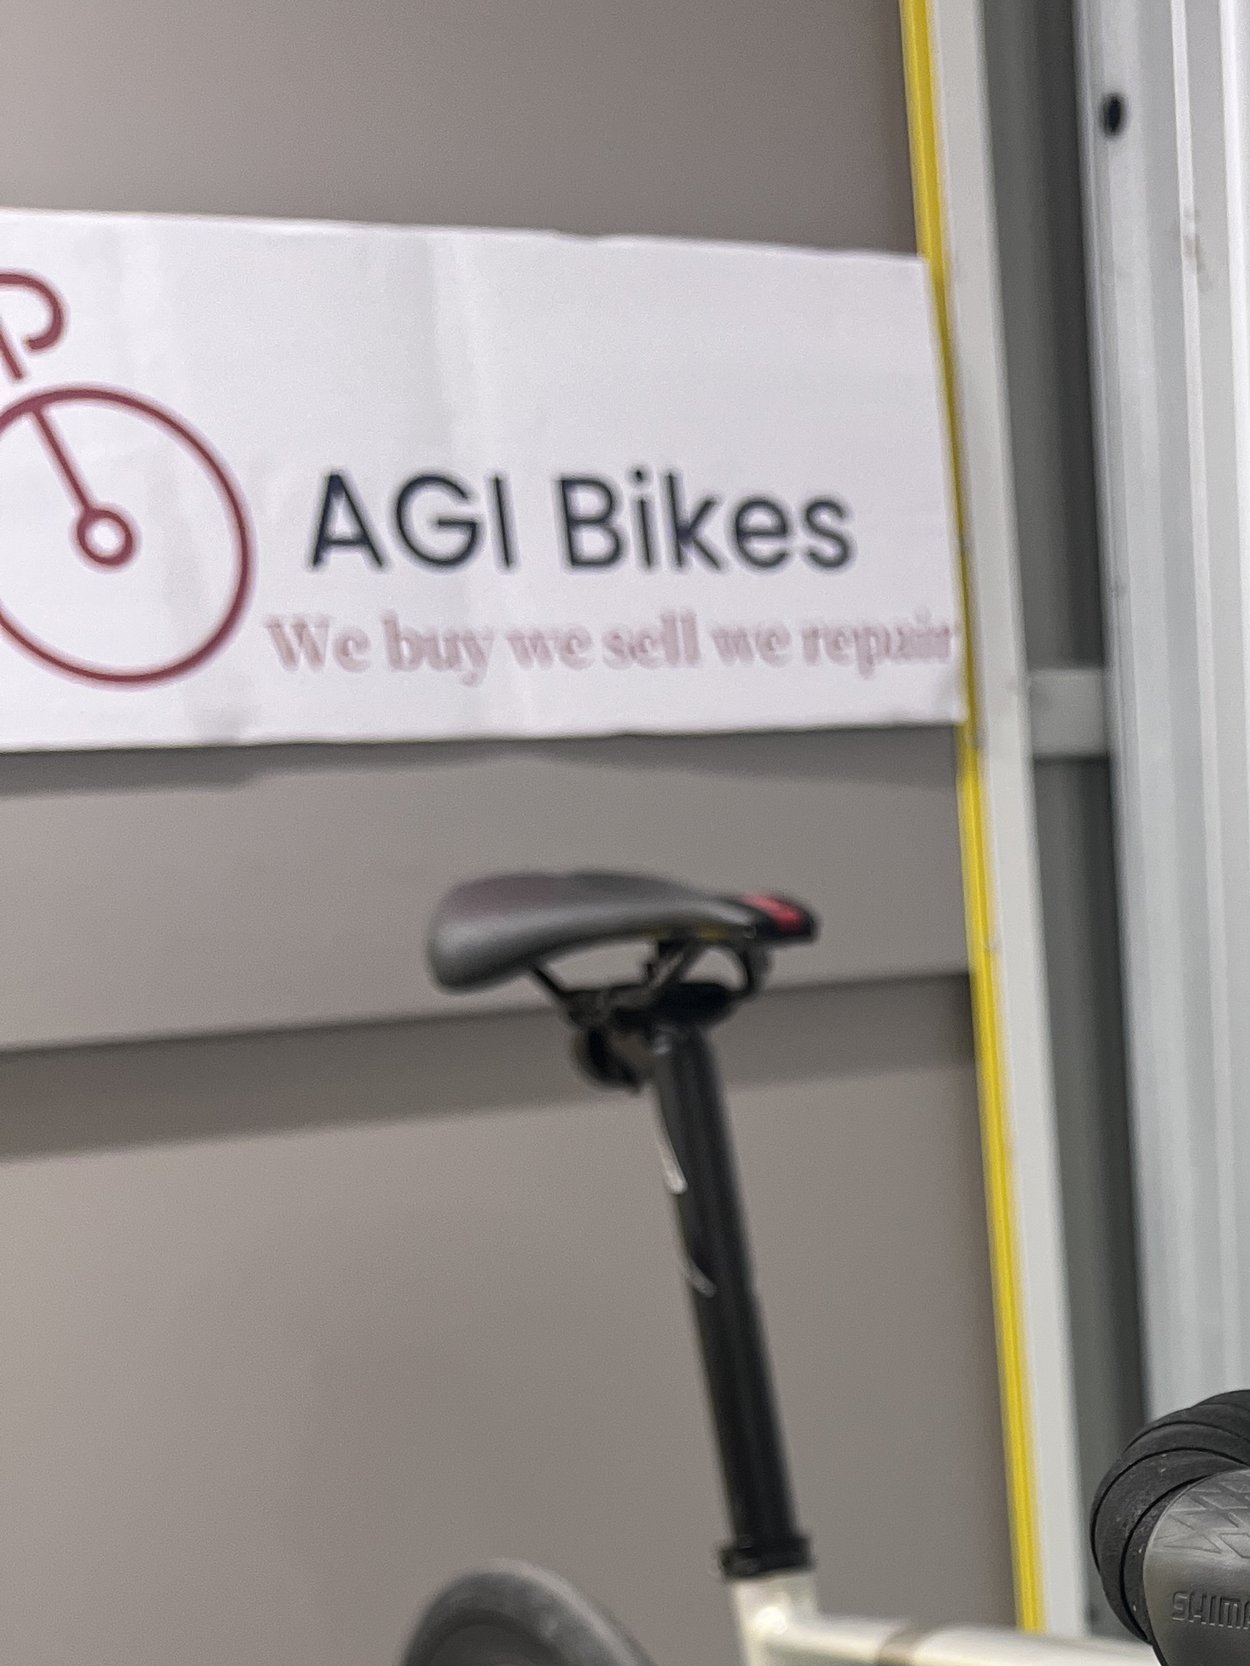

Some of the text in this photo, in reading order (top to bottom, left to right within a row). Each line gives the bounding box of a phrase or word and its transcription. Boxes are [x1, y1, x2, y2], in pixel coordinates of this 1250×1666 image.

[311, 469, 856, 571] AGI Bikes
[264, 606, 953, 687] We buy we sell we repair
